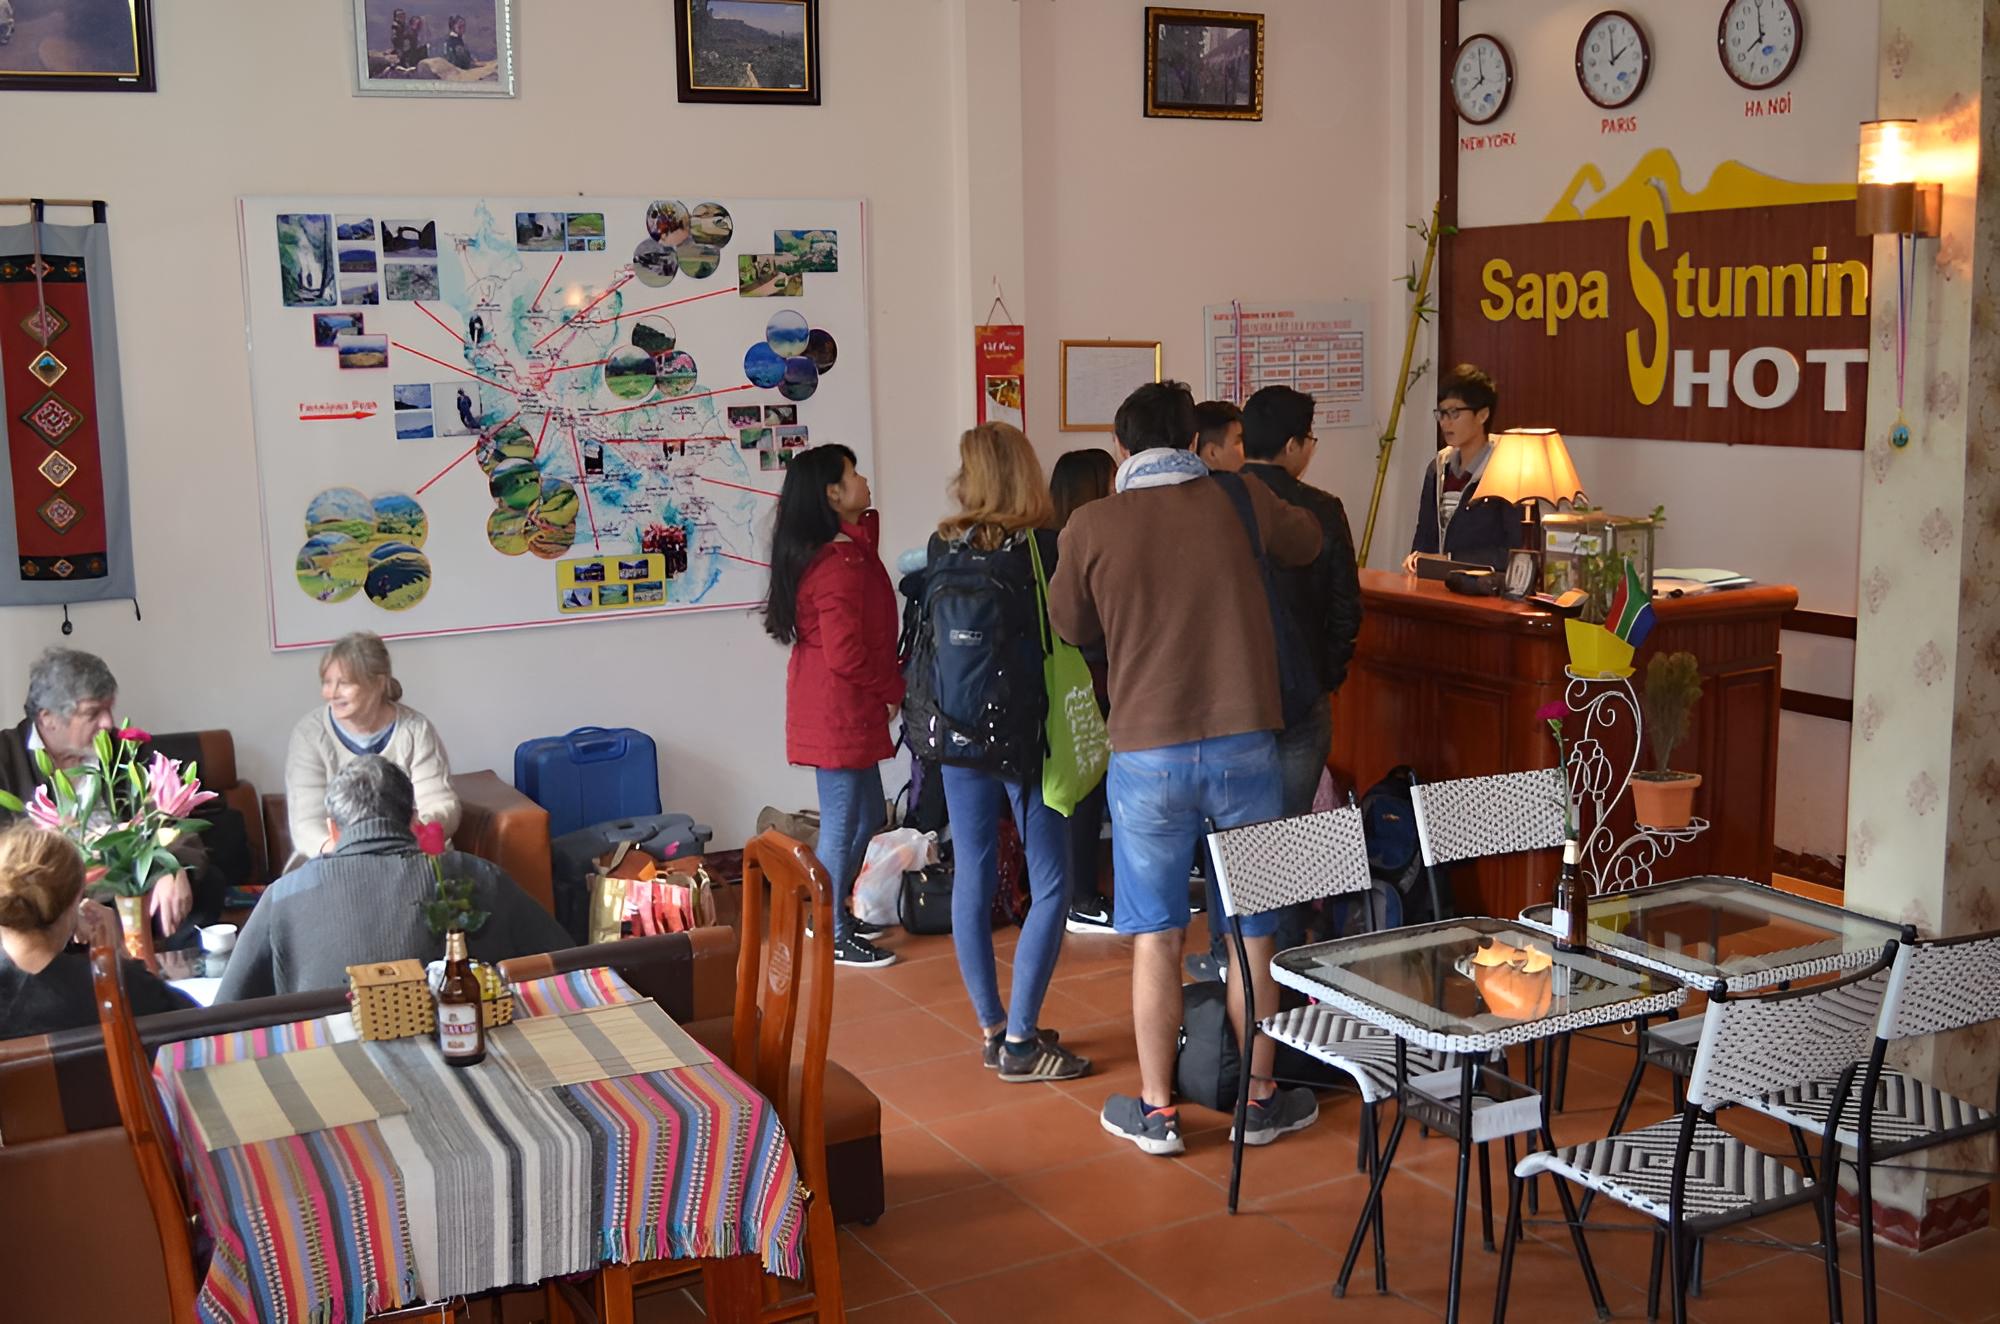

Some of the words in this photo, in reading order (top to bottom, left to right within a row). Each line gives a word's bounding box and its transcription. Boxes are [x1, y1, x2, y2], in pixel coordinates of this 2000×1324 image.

[1745, 100, 1763, 117] HA
[1601, 116, 1637, 134] PARIS
[1460, 136, 1484, 151] NEW
[1486, 131, 1517, 148] YORK
[1480, 258, 1608, 336] Sapa
[1672, 347, 1868, 412] HOT
